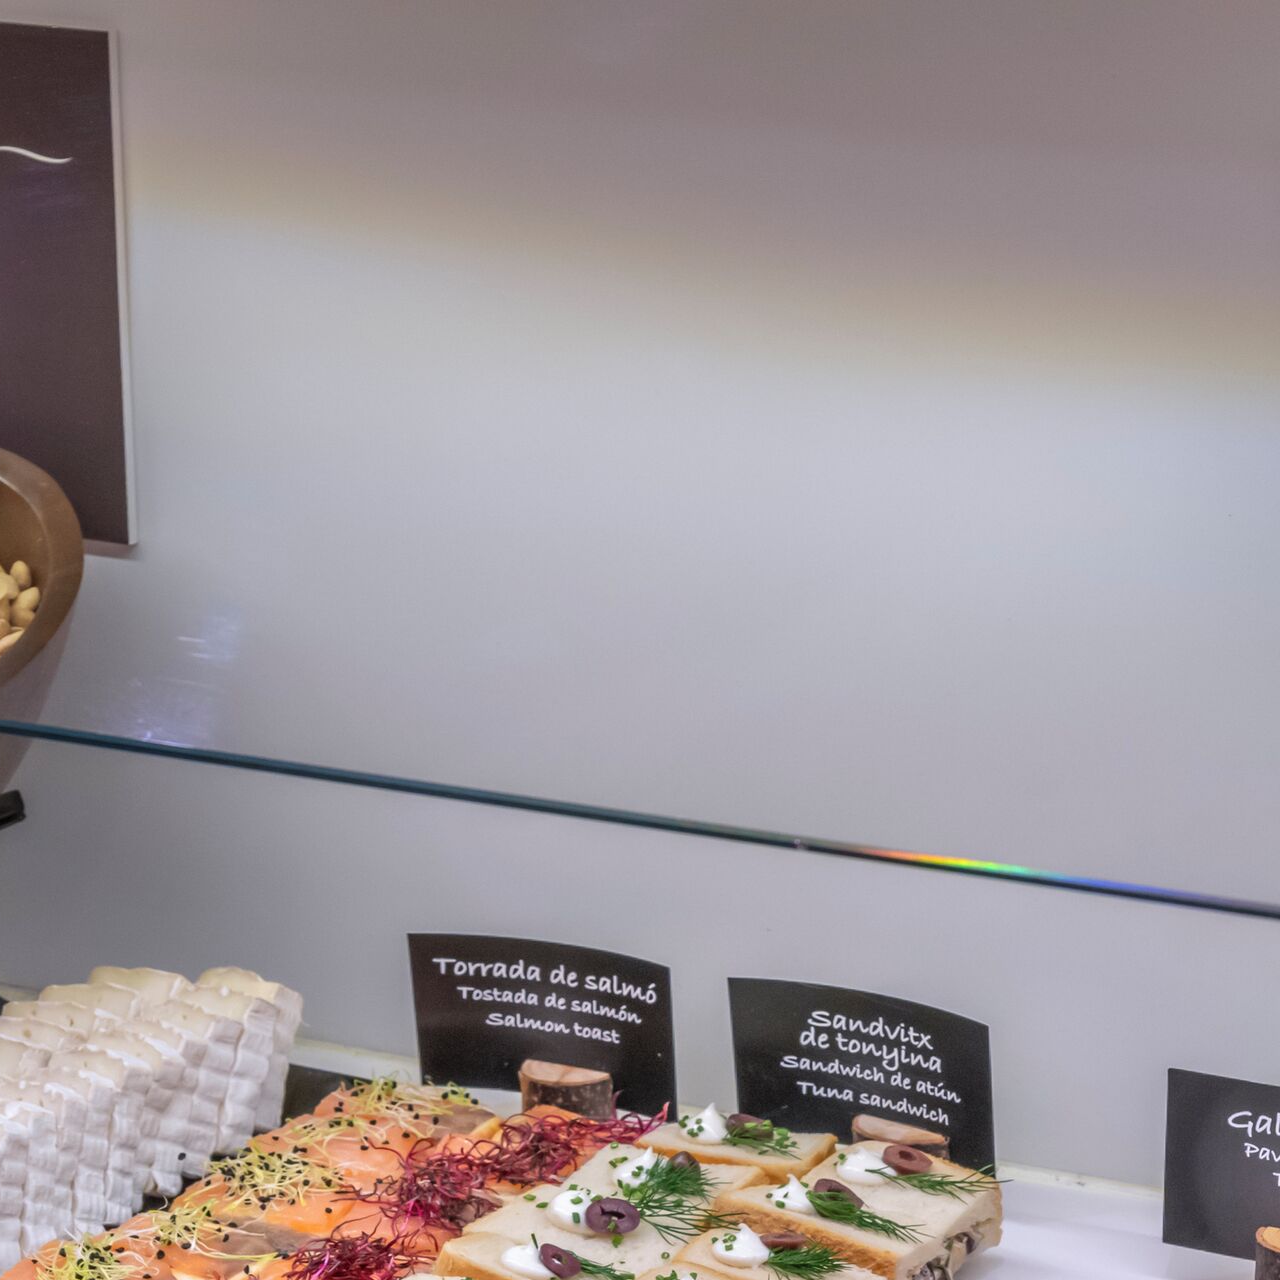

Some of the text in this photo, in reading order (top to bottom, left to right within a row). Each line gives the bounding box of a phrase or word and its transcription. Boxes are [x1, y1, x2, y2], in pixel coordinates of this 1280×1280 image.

[432, 957, 658, 1005] Torrada de salmó
[456, 986, 643, 1025] Tostada de salmón
[485, 1012, 620, 1045] Salmon toast
[808, 1010, 933, 1050] Sandvitx
[799, 1025, 942, 1073] de tonyina
[796, 1080, 949, 1126] Tuna sandwich
[890, 1071, 912, 1090] de
[915, 1080, 962, 1104] atún
